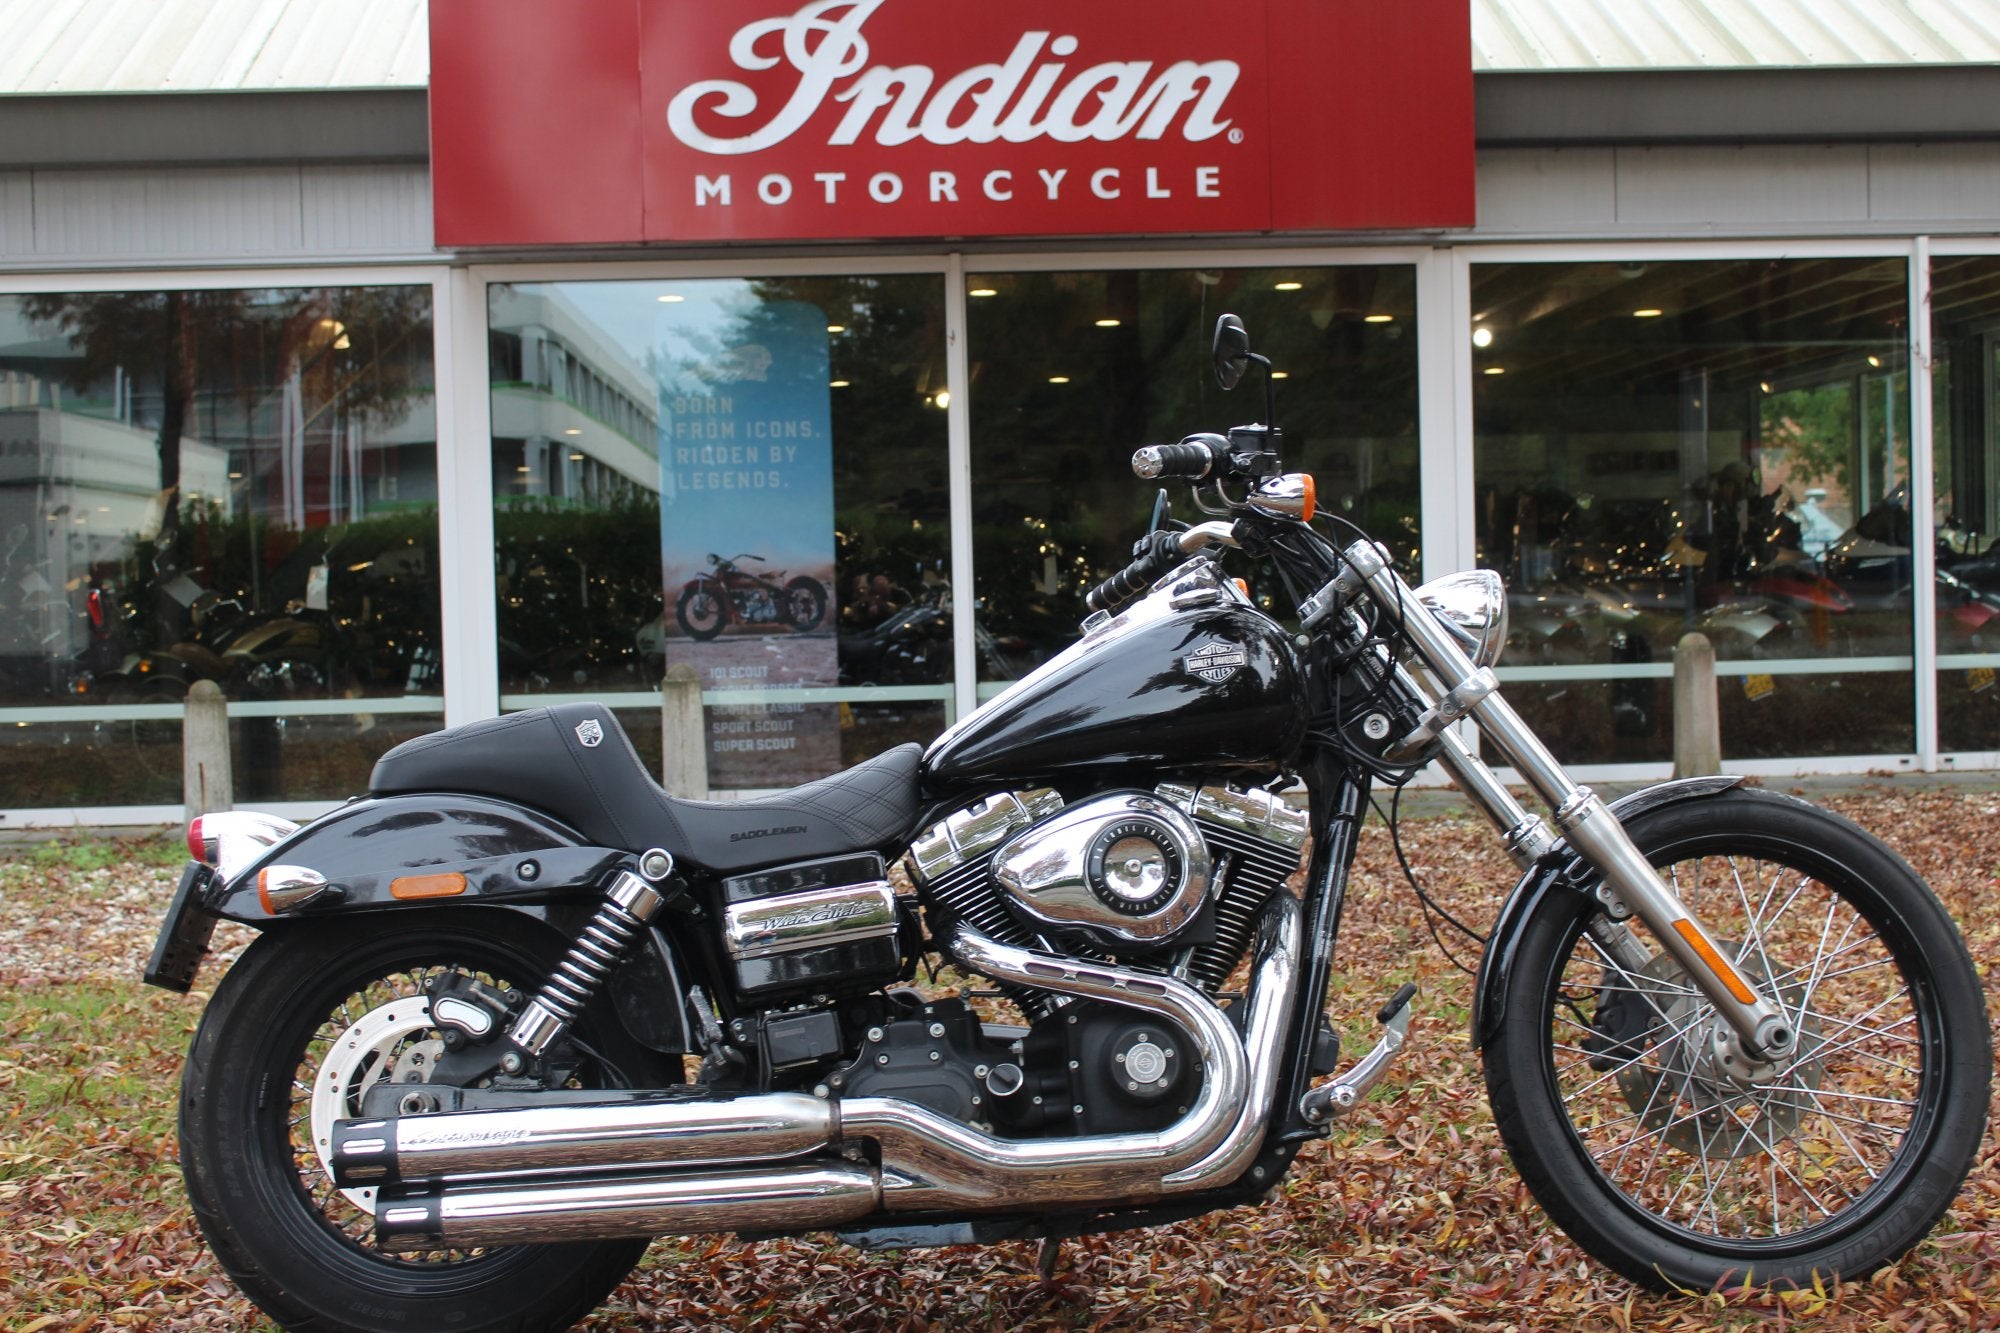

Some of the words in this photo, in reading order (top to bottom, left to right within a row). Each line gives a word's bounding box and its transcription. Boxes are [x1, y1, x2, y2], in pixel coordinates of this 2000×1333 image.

[667, 0, 1240, 154] Indian
[695, 166, 1221, 206] MOTORCYCLE
[675, 397, 733, 414] BORN
[676, 421, 735, 439] FROM
[746, 420, 821, 438] ICONS.
[677, 446, 758, 465] RIDDEN
[770, 446, 797, 463] BY
[678, 471, 789, 490] LEGENDS.
[1189, 654, 1242, 669] HARLEY-DAVIDSON
[710, 666, 726, 679] 101
[729, 666, 768, 679] SCOUT
[1203, 667, 1233, 679] CYCLES
[713, 721, 752, 734] SPORT
[755, 719, 794, 732] SCOUT
[713, 739, 754, 752] SUPER
[756, 737, 796, 750] SCOUT
[730, 825, 808, 843] SADDLEMEN
[762, 913, 811, 931] Wide
[811, 903, 873, 922] Glide
